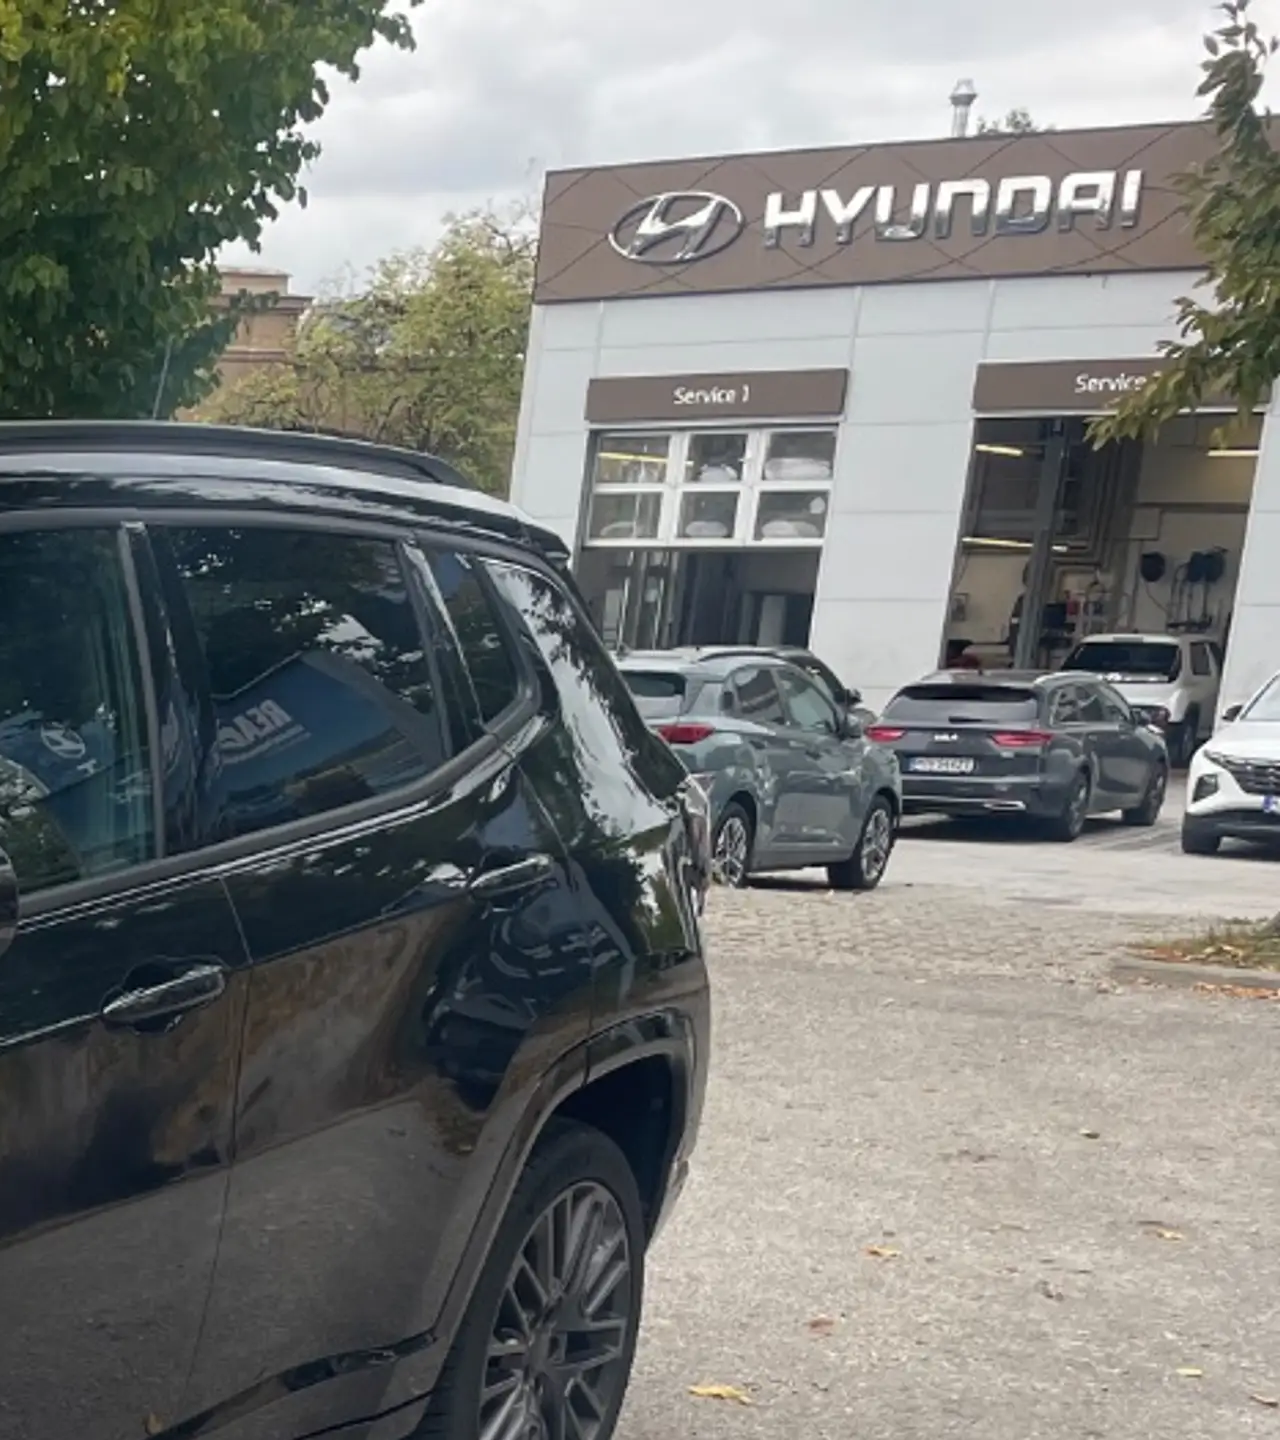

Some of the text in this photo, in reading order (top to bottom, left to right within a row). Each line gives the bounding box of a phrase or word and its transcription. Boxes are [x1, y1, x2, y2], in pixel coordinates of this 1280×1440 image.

[763, 169, 1144, 249] HYUNDAI
[1074, 372, 1147, 394] Service
[673, 385, 736, 405] Service
